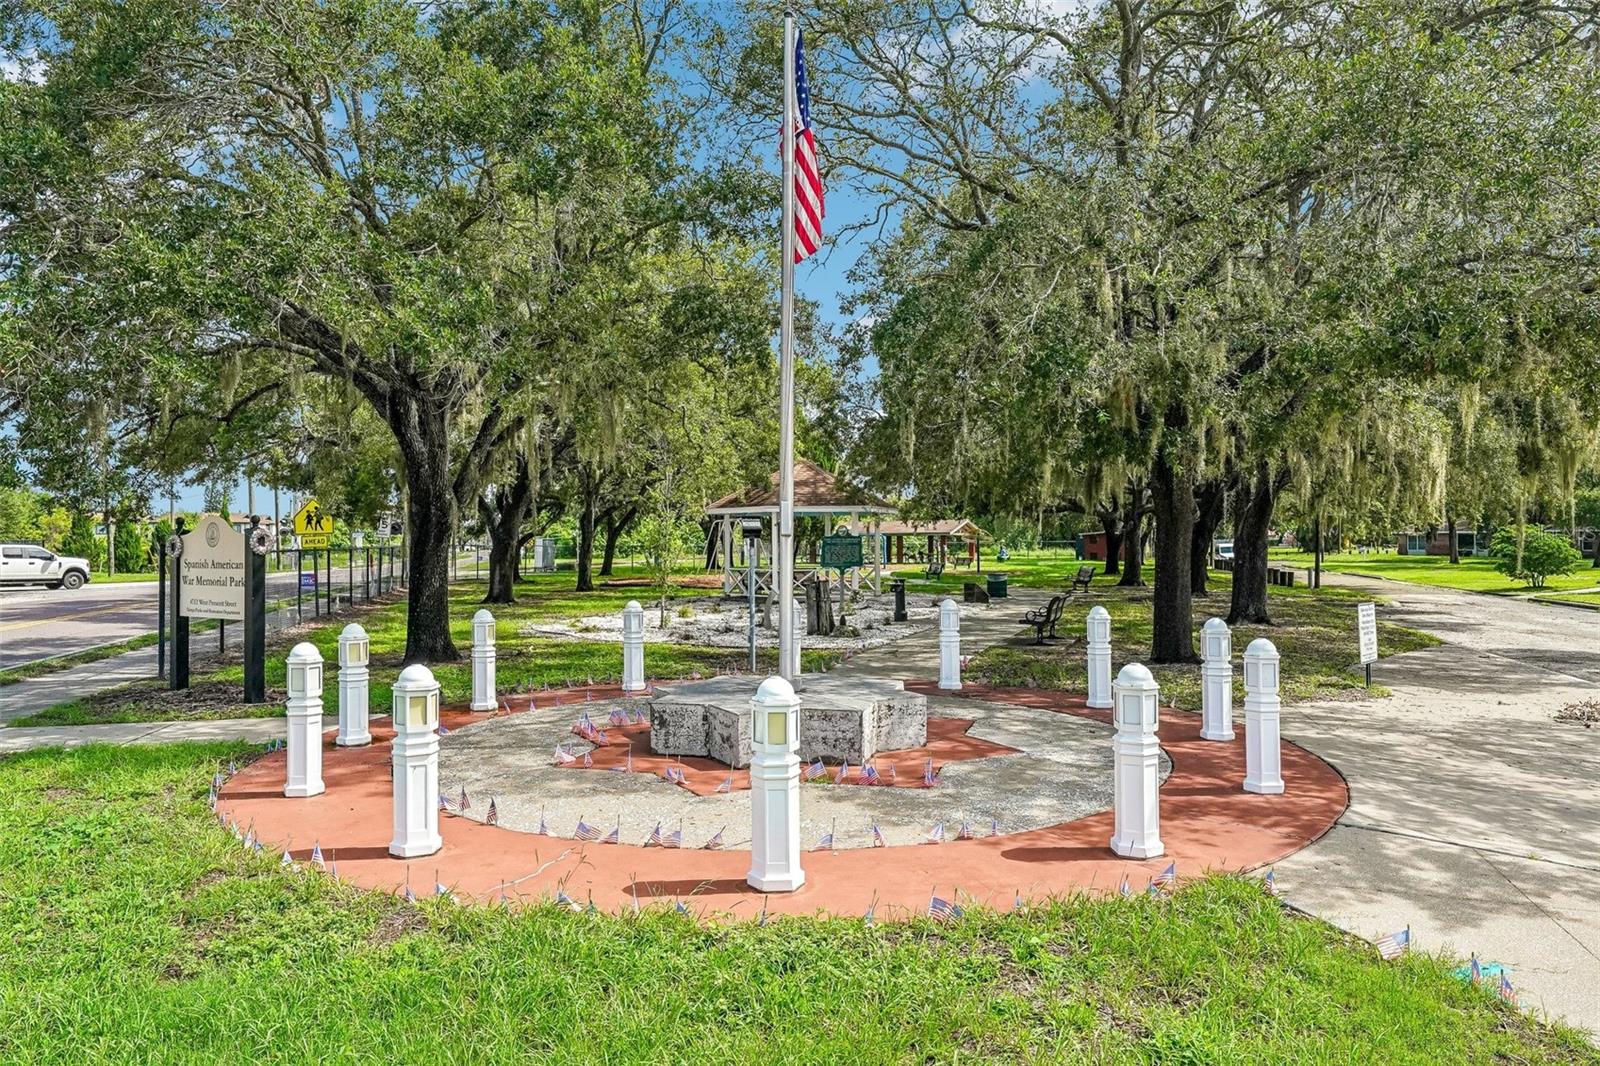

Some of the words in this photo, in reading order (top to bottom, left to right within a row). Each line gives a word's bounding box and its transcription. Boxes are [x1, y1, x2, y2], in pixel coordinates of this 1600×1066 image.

[183, 559, 210, 571] Spanish
[210, 559, 244, 569] American
[182, 575, 194, 586] War
[195, 575, 228, 587] Memorial
[229, 576, 246, 587] Park
